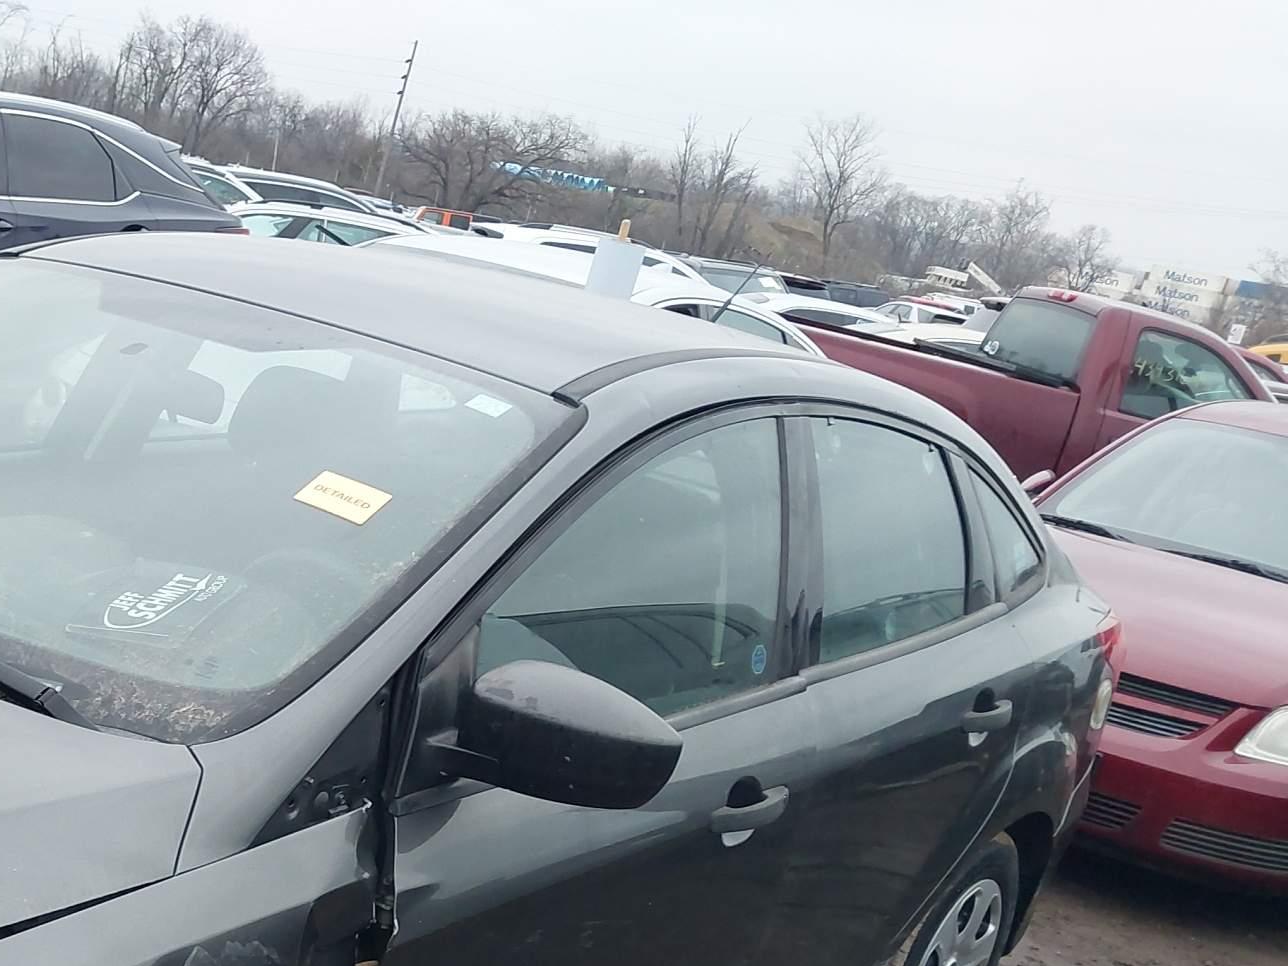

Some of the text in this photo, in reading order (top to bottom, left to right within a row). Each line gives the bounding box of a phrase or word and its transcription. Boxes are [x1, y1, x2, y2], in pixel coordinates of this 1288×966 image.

[1164, 270, 1208, 287] Matson
[1155, 286, 1199, 302] Matson
[313, 483, 371, 510] DETAILED
[109, 591, 145, 611] JEFF
[127, 573, 200, 620] SCHMITT
